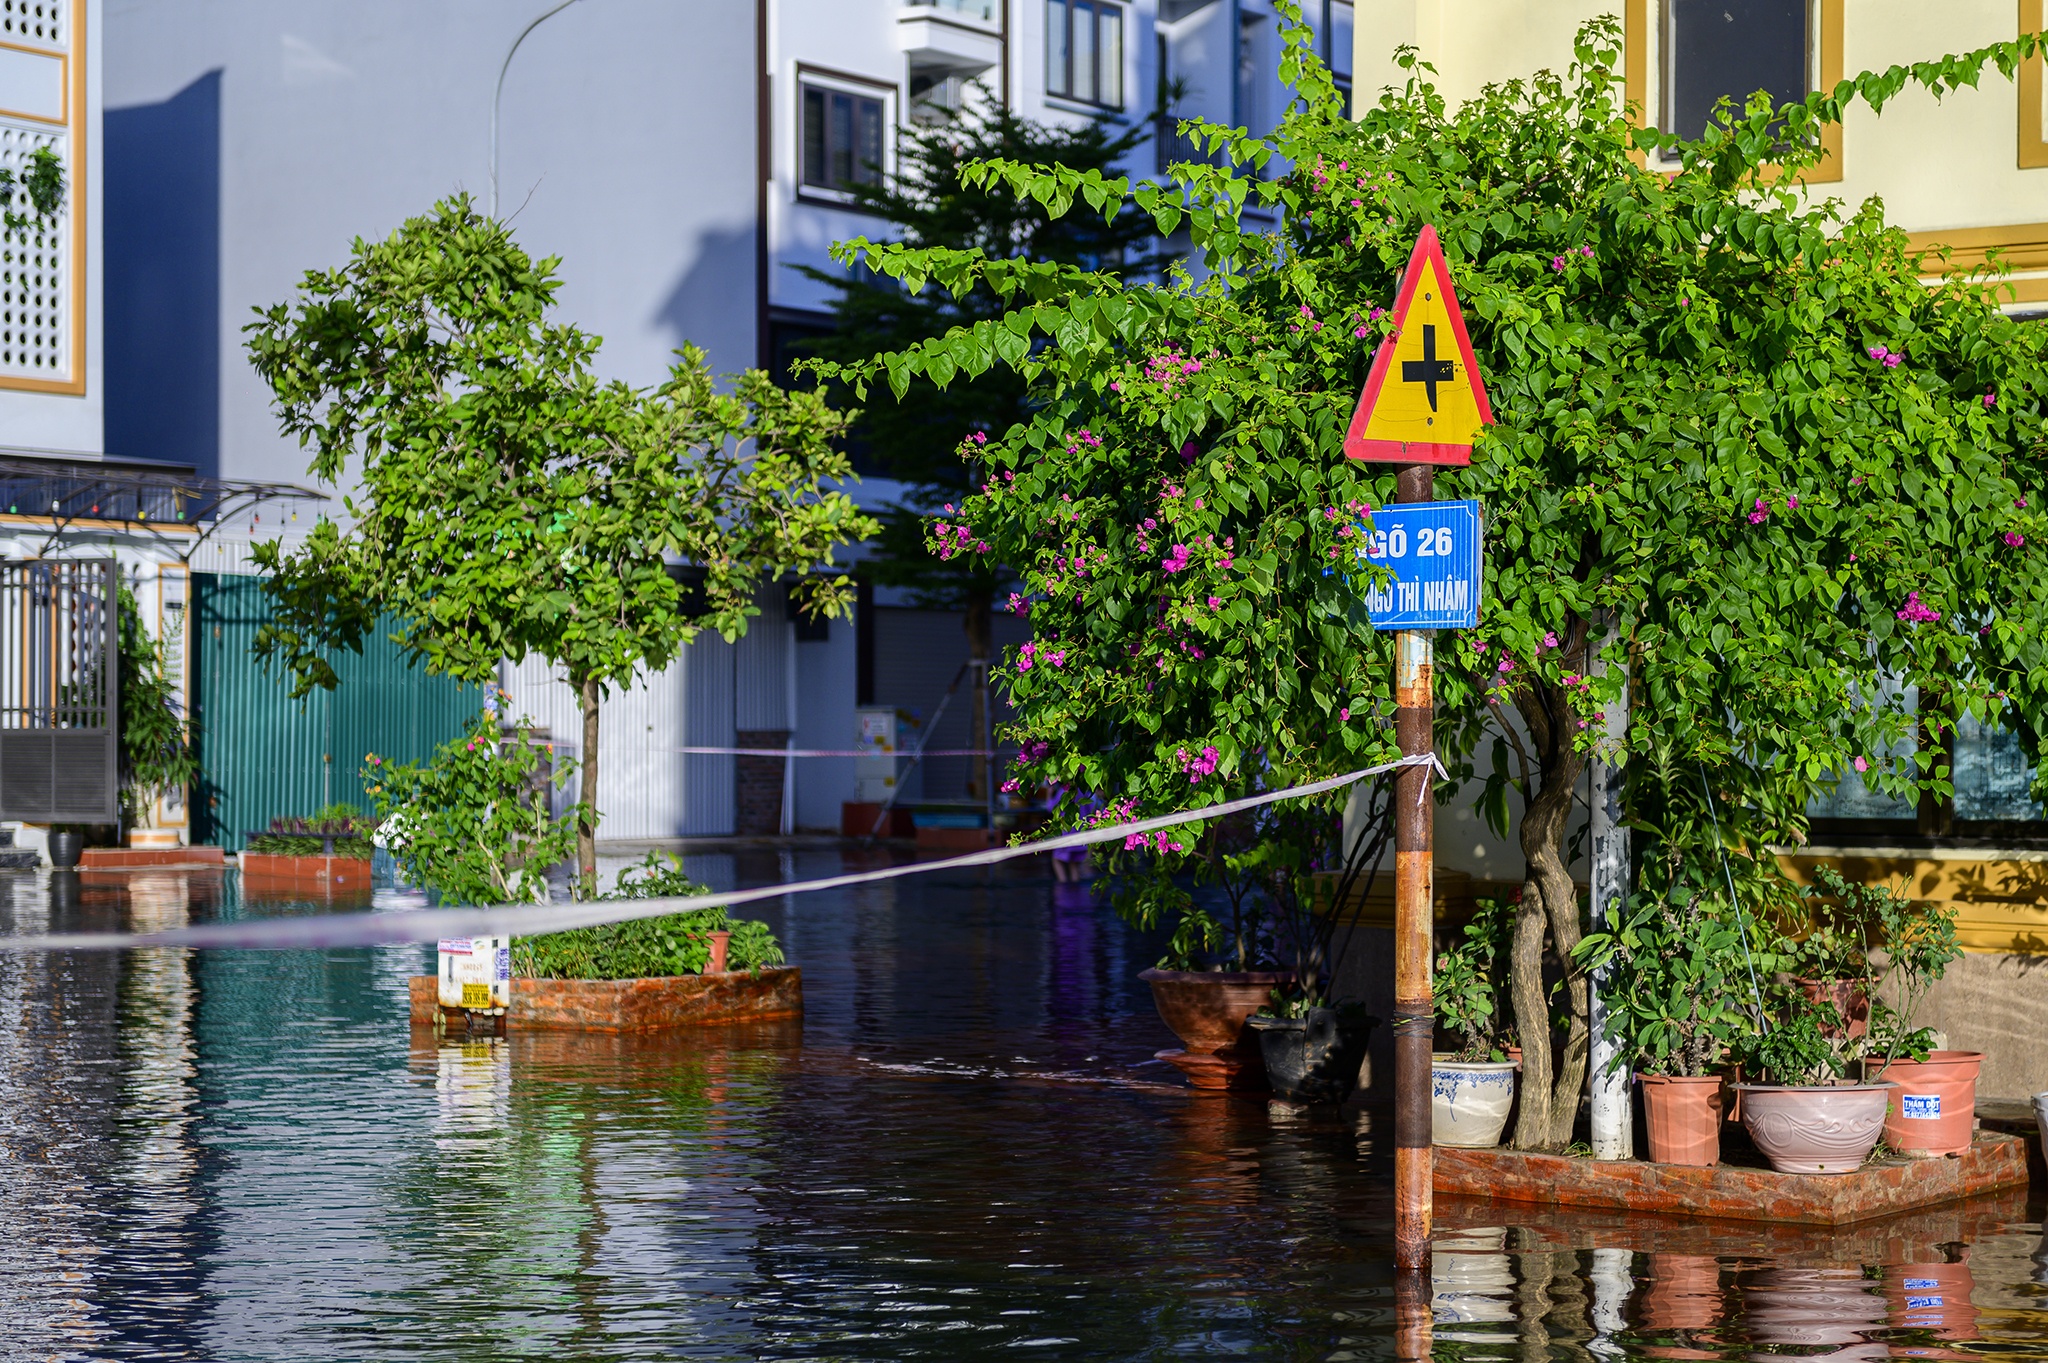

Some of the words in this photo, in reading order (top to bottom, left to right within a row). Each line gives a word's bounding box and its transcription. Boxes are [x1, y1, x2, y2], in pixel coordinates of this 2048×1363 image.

[1416, 527, 1453, 557] 26
[1397, 575, 1420, 612] THÌ
[1424, 574, 1468, 618] NHẬM
